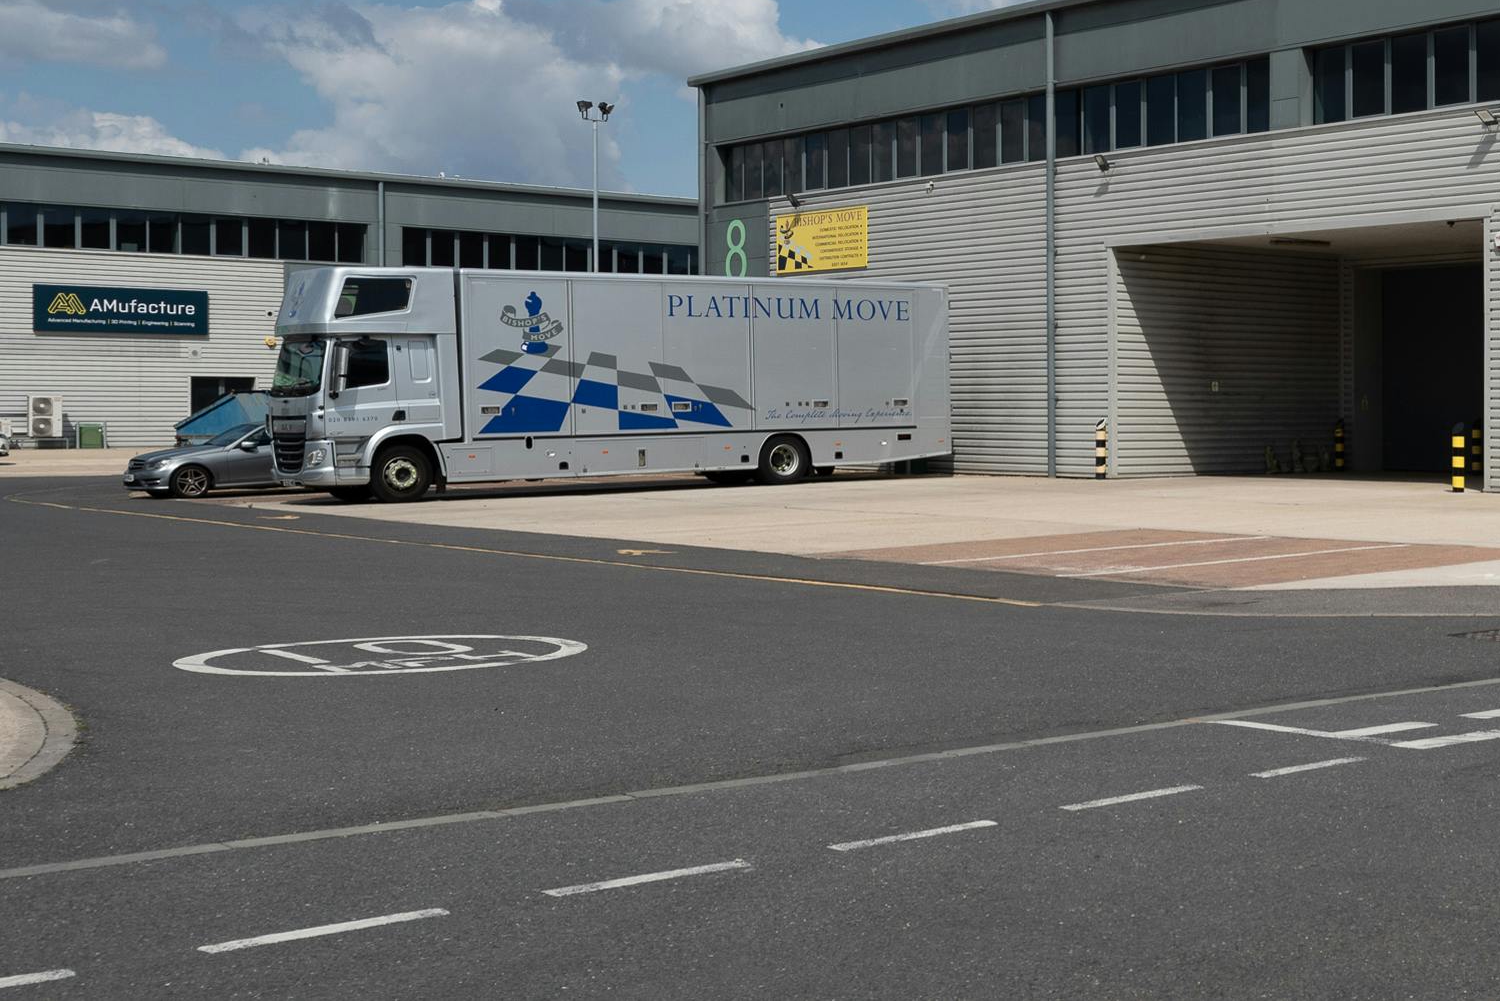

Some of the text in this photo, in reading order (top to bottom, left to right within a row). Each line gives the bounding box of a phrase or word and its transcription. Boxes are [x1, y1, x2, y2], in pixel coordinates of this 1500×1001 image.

[794, 210, 863, 227] BISHOP'S MOVE
[726, 219, 748, 277] 8
[89, 298, 196, 315] AMufacture
[667, 294, 910, 322] PLATINUM MOVE
[501, 313, 548, 328] BISHOP'S
[530, 327, 559, 341] MOVE
[765, 408, 781, 420] The
[785, 408, 826, 424] Complete
[828, 408, 863, 424] Moving
